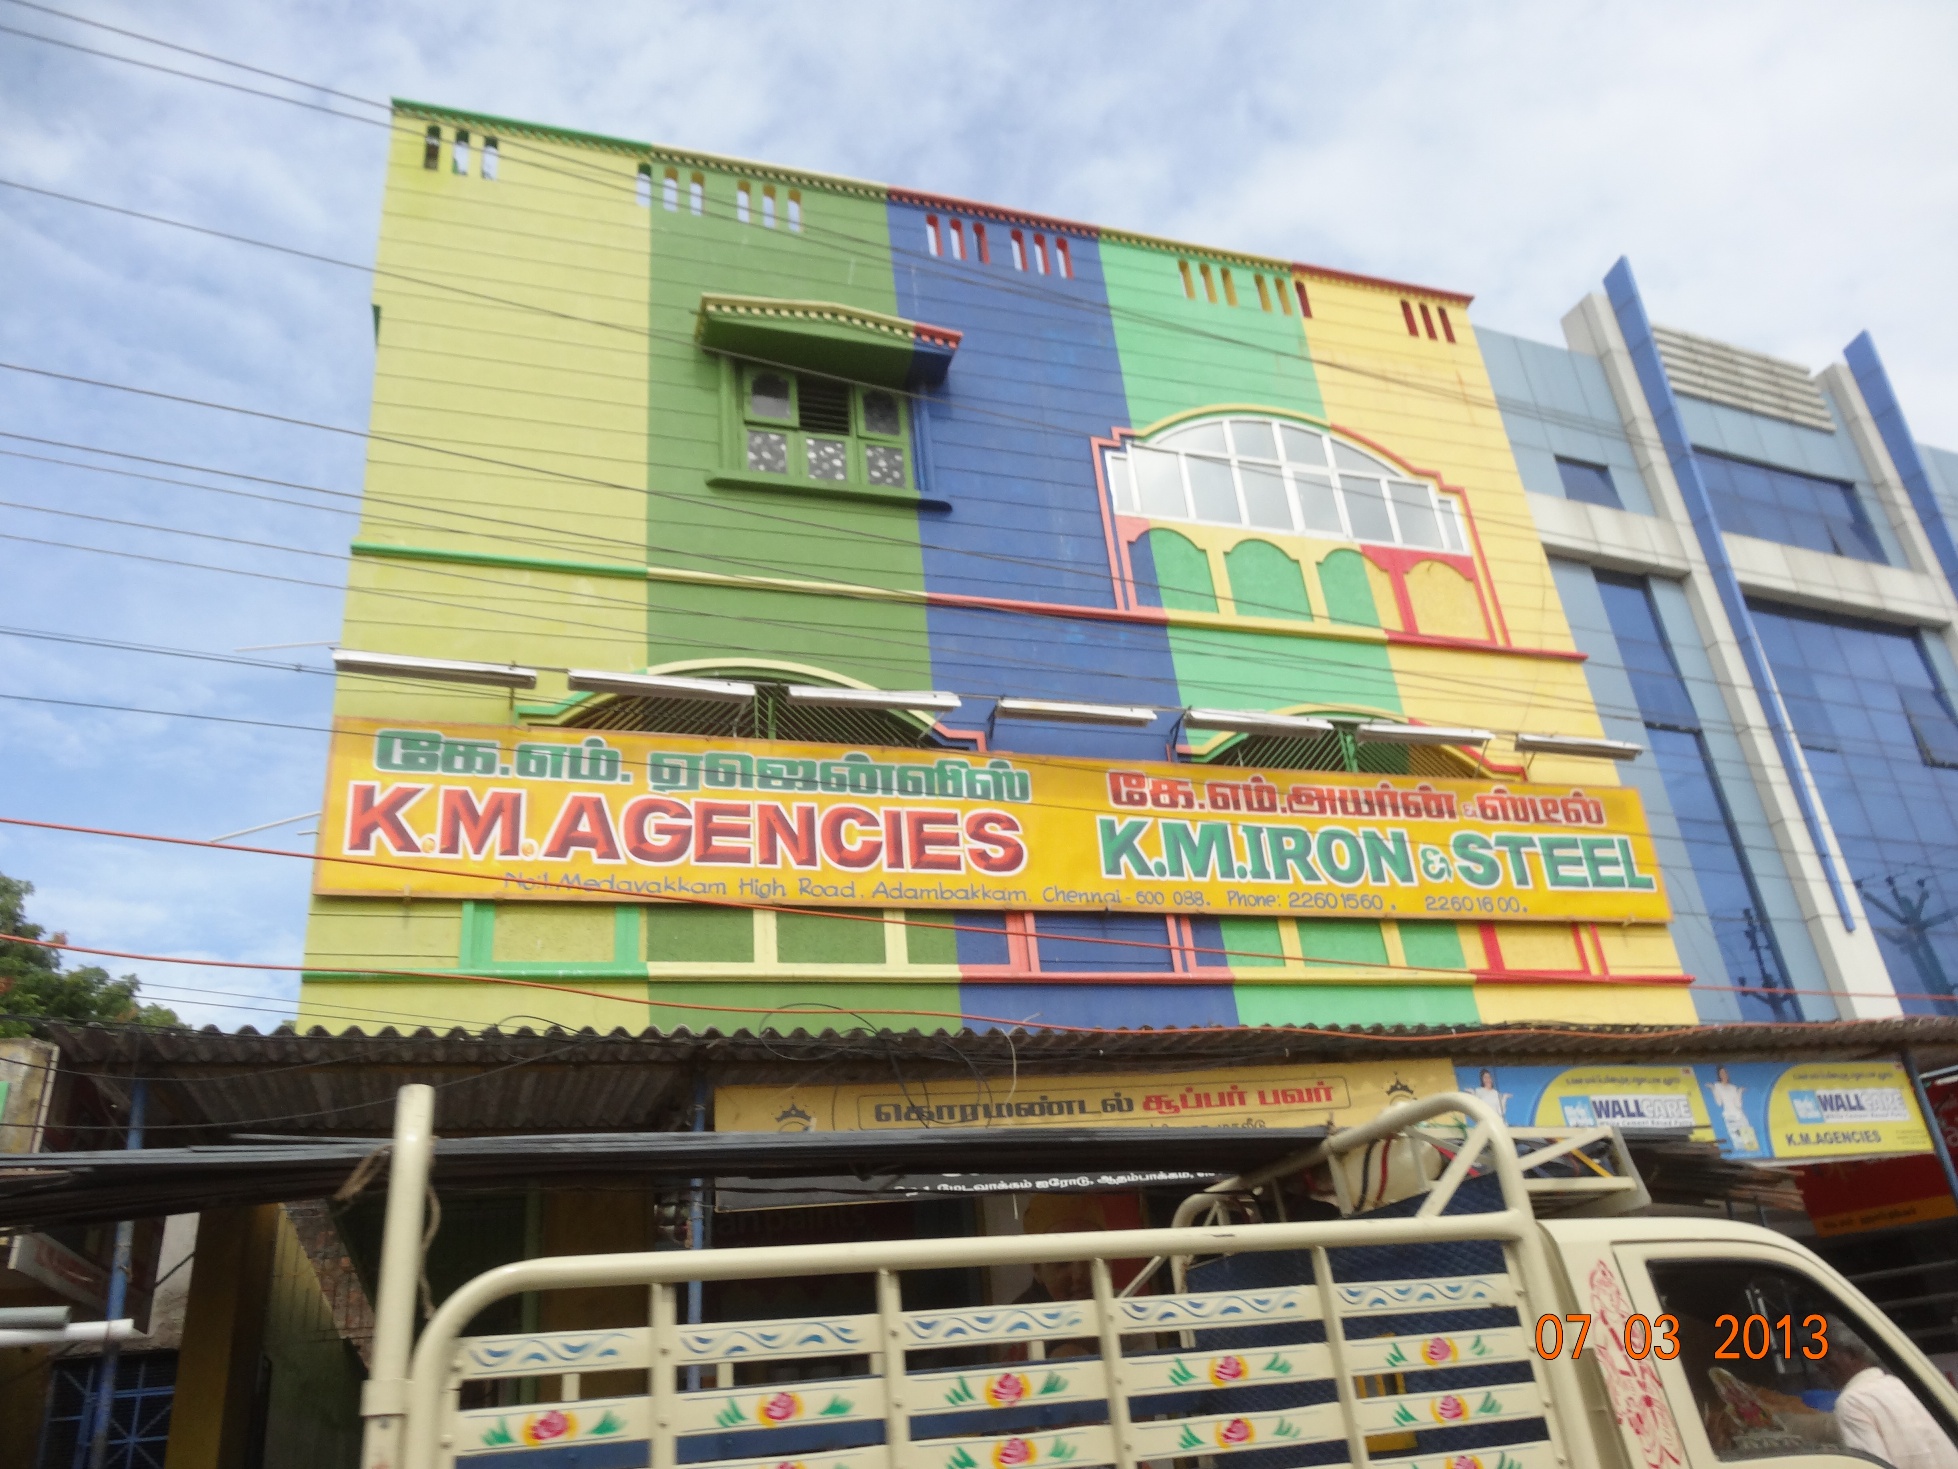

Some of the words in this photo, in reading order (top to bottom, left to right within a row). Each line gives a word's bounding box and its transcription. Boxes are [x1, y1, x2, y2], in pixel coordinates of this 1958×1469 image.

[1418, 844, 1453, 883] &
[1450, 829, 1658, 893] STEEL
[557, 872, 727, 895] Medavakkam
[739, 877, 786, 899] High
[1227, 889, 1280, 908] Phone:
[1142, 1085, 1247, 1115] சூப்பர்
[1258, 1080, 1332, 1106] பவர்
